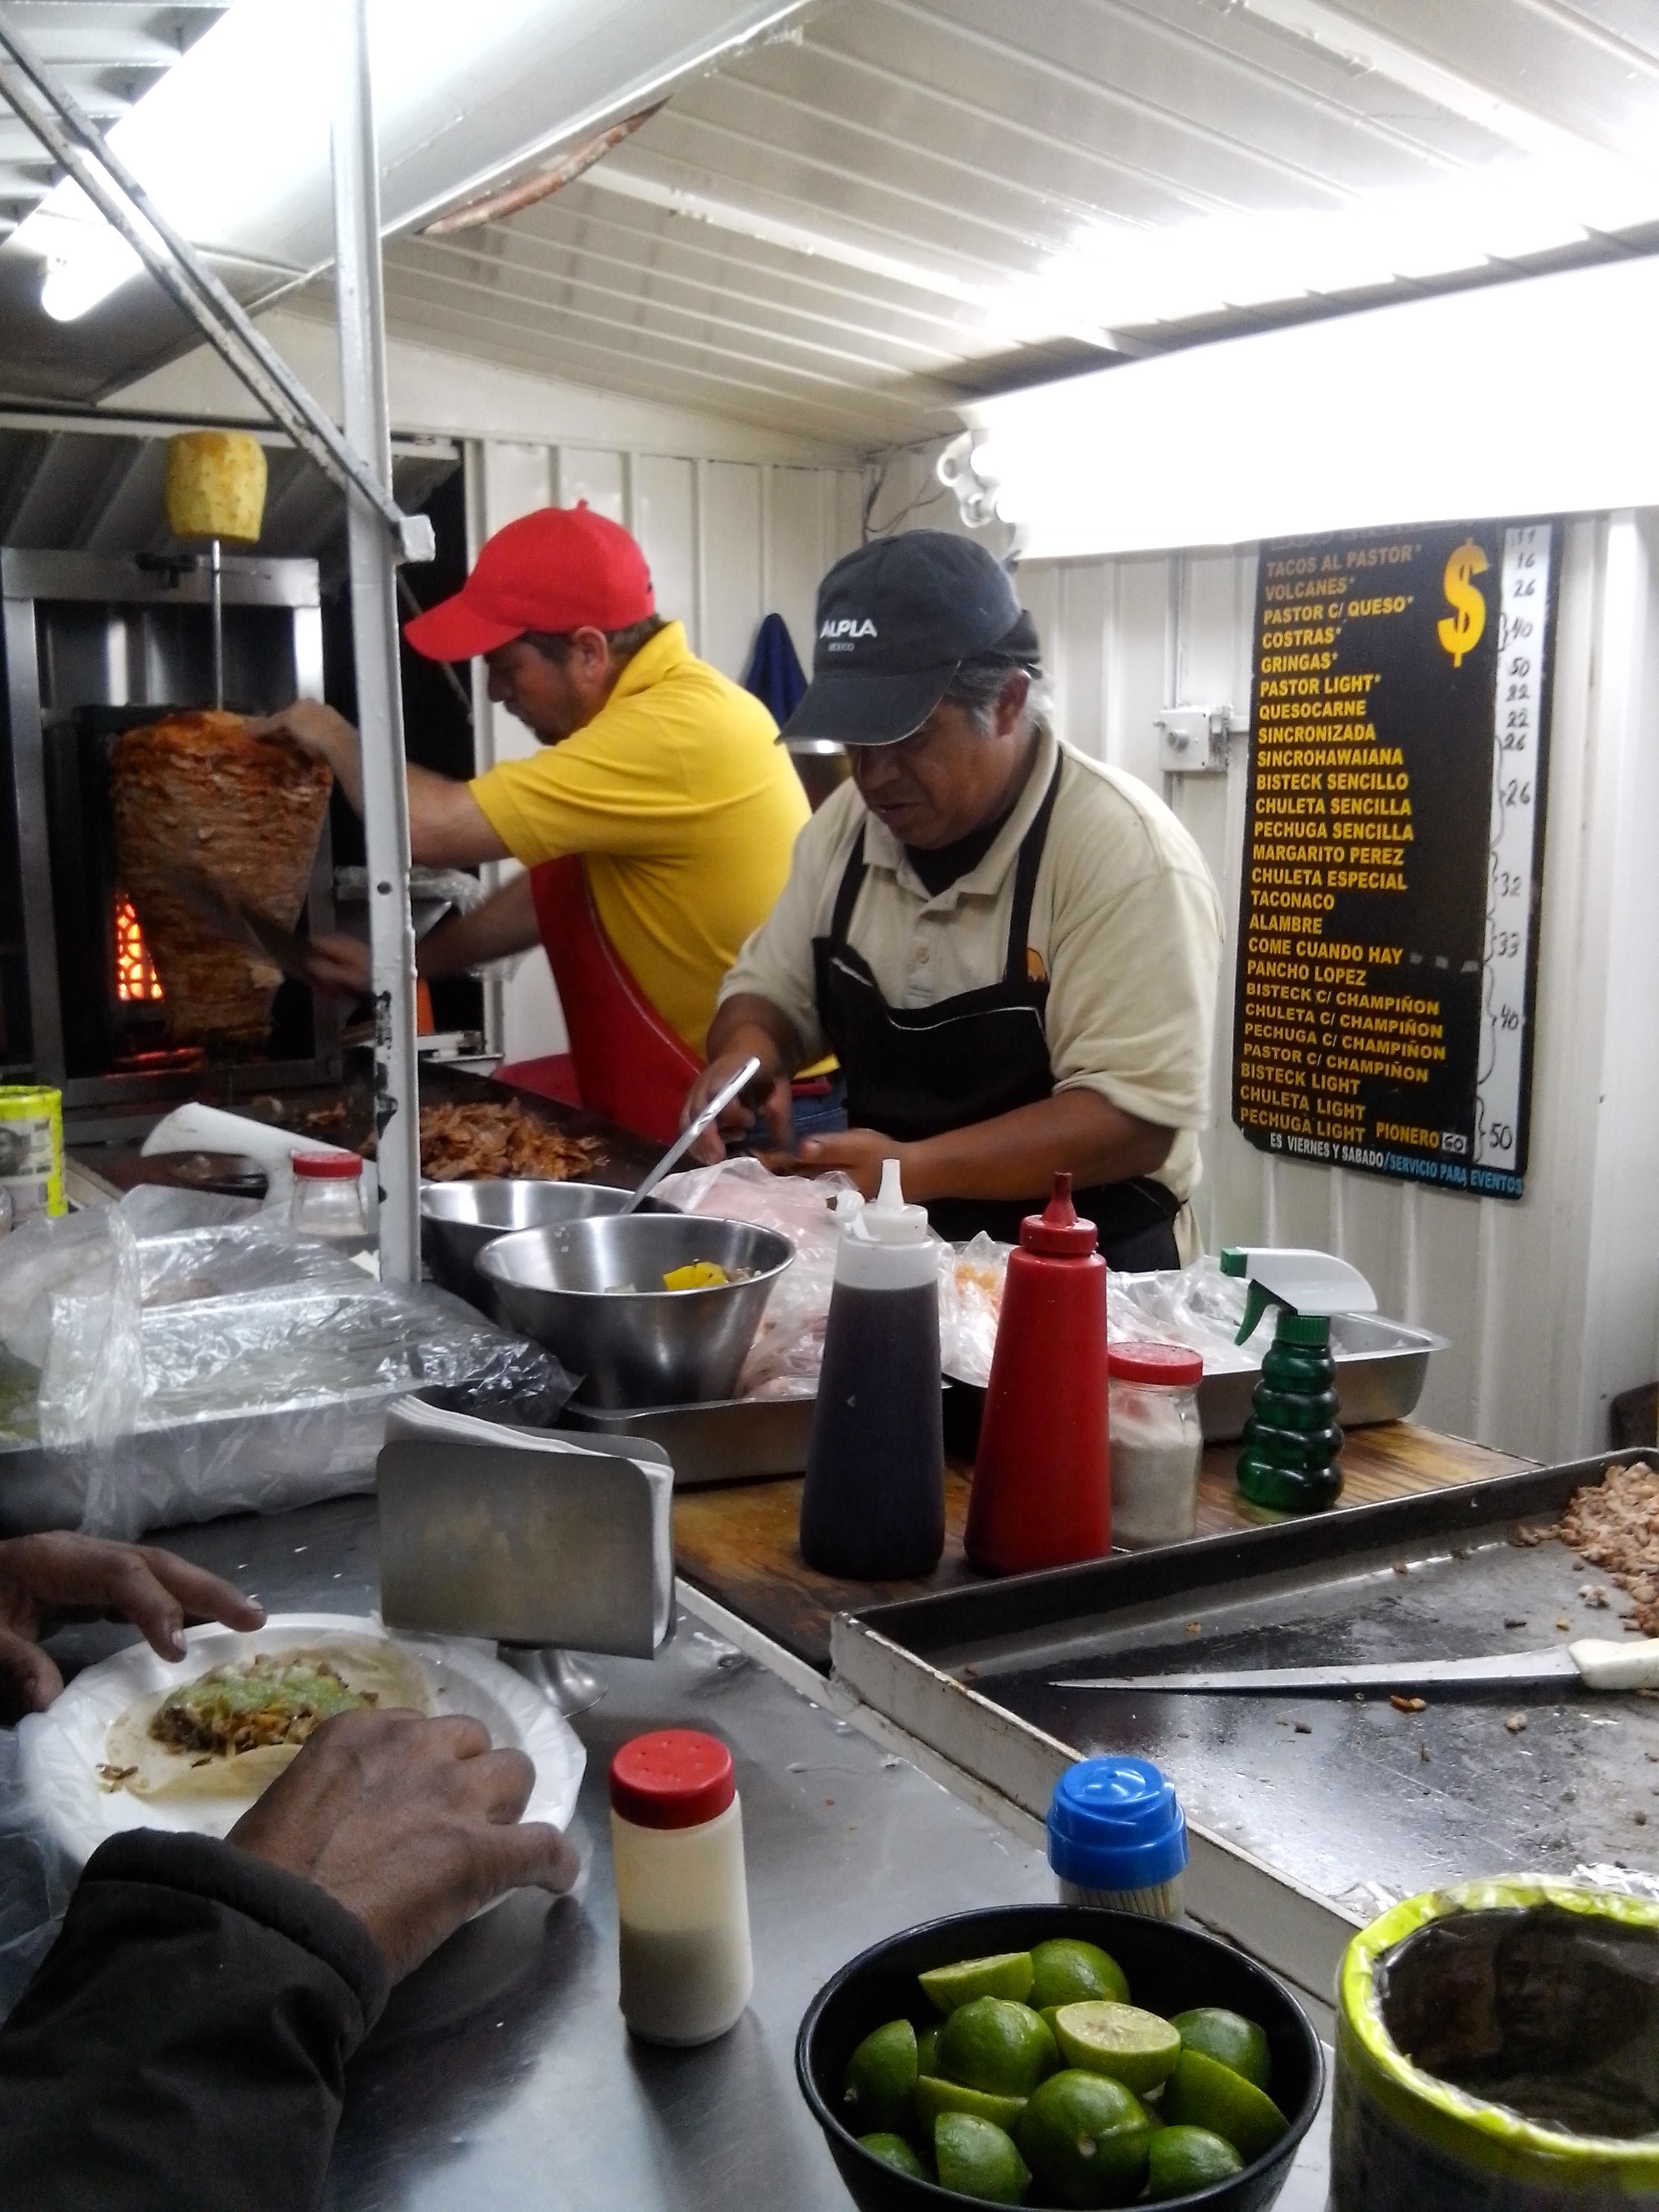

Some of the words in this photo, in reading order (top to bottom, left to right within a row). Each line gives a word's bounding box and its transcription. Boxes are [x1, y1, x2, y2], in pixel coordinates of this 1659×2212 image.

[1266, 558, 1316, 578] TACOS
[1322, 556, 1341, 572] AL
[1518, 552, 1535, 569] 16
[1513, 578, 1536, 598] 26
[1263, 607, 1322, 625] PASTOR
[820, 619, 878, 638] ALPLA
[1260, 678, 1319, 697] PASTOR
[1259, 701, 1366, 720] QUESOCARNE
[1258, 724, 1376, 743] SINCRONIZADA
[1502, 732, 1527, 751] 26
[1256, 748, 1404, 767] SINCROHAWAIANA
[1256, 774, 1322, 790] BISTECK
[1327, 773, 1409, 790] SENCILLO
[1506, 779, 1530, 806] 26
[1255, 798, 1326, 814] CHULETA
[1330, 798, 1412, 816] SENCILLA
[1254, 823, 1327, 838] PECHUGA
[1333, 823, 1414, 841] SENCILLA
[1252, 845, 1345, 863] MARGARITO
[1350, 848, 1404, 865] PEREZ
[1251, 868, 1322, 885] CHULETA
[1327, 870, 1407, 890] ESPECIAL
[1501, 872, 1521, 897] 32
[1250, 890, 1334, 909] TACONACO
[1249, 914, 1322, 935] ALAMBRE
[1248, 937, 1291, 955] COME
[1296, 941, 1364, 962] CUANDO
[1368, 945, 1403, 964] HAY
[1498, 931, 1519, 958] 33
[1247, 960, 1309, 979] PANCHO
[1314, 965, 1367, 986] LOPEZ
[1246, 983, 1311, 1001] BISTECK
[1336, 992, 1440, 1015] CHAMPIÑON
[1246, 1004, 1314, 1023] CHULETA
[1340, 1014, 1443, 1038] CHAMPIÑON
[1500, 1004, 1519, 1030] 40
[1244, 1023, 1317, 1044] PECHUGA
[1342, 1033, 1446, 1060] CHAMPIÑON
[1244, 1044, 1301, 1063] PASTOR
[1326, 1056, 1429, 1082] CHAMPIÑON
[1241, 1063, 1306, 1086] BISTECK
[1312, 1073, 1360, 1094] LIGHT
[1240, 1086, 1309, 1111] CHULETA
[1317, 1099, 1366, 1120] LIGHT
[1240, 1107, 1312, 1134] PECHUGA
[1317, 1121, 1366, 1143] LIGHT
[1376, 1122, 1439, 1148] PIONERO
[1490, 1122, 1513, 1150] 50
[1270, 1132, 1282, 1149] ES
[1288, 1135, 1330, 1158] VIERNES
[1332, 1144, 1340, 1159] Y
[1440, 1164, 1467, 1184] PARA
[1471, 1169, 1523, 1195] EVENTOS
